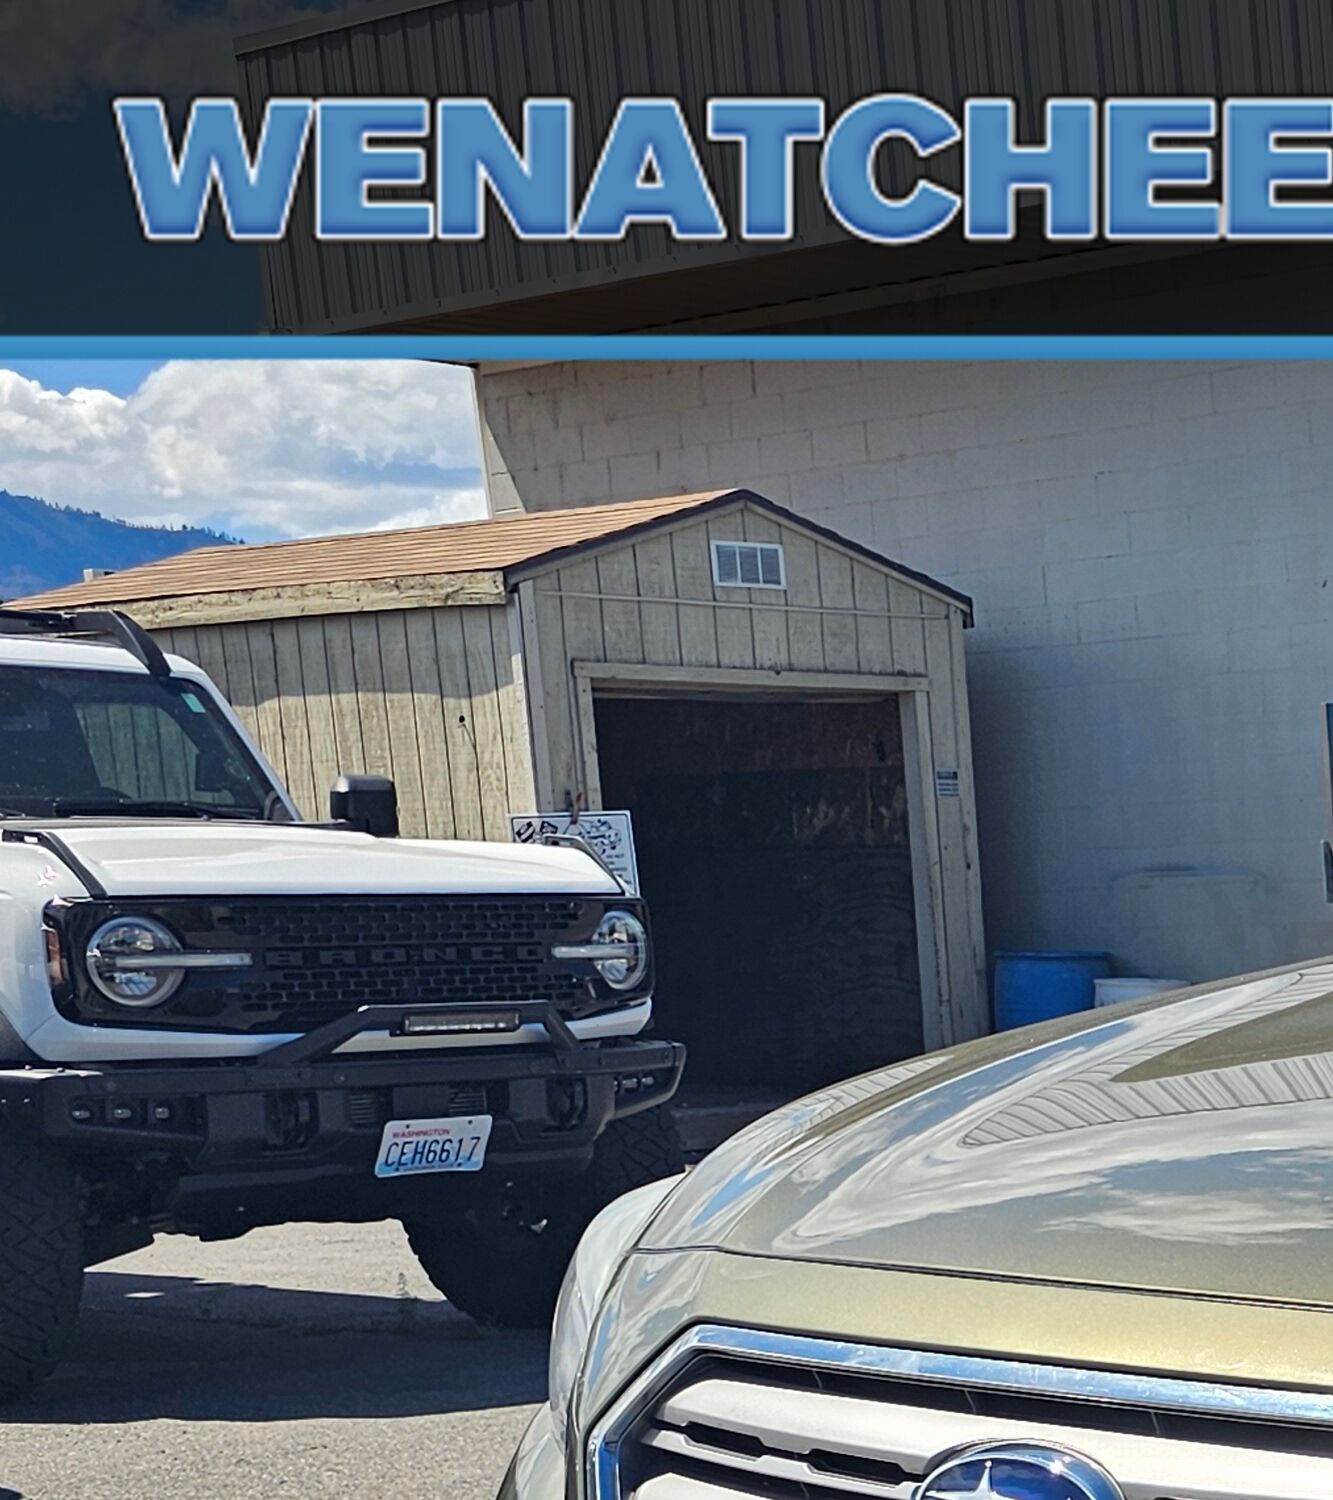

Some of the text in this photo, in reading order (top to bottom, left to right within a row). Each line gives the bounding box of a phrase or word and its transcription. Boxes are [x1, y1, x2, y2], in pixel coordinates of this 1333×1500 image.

[265, 945, 545, 967] BRONCO
[392, 1127, 452, 1139] WASHINGTON
[384, 1136, 482, 1168] CEH6617
